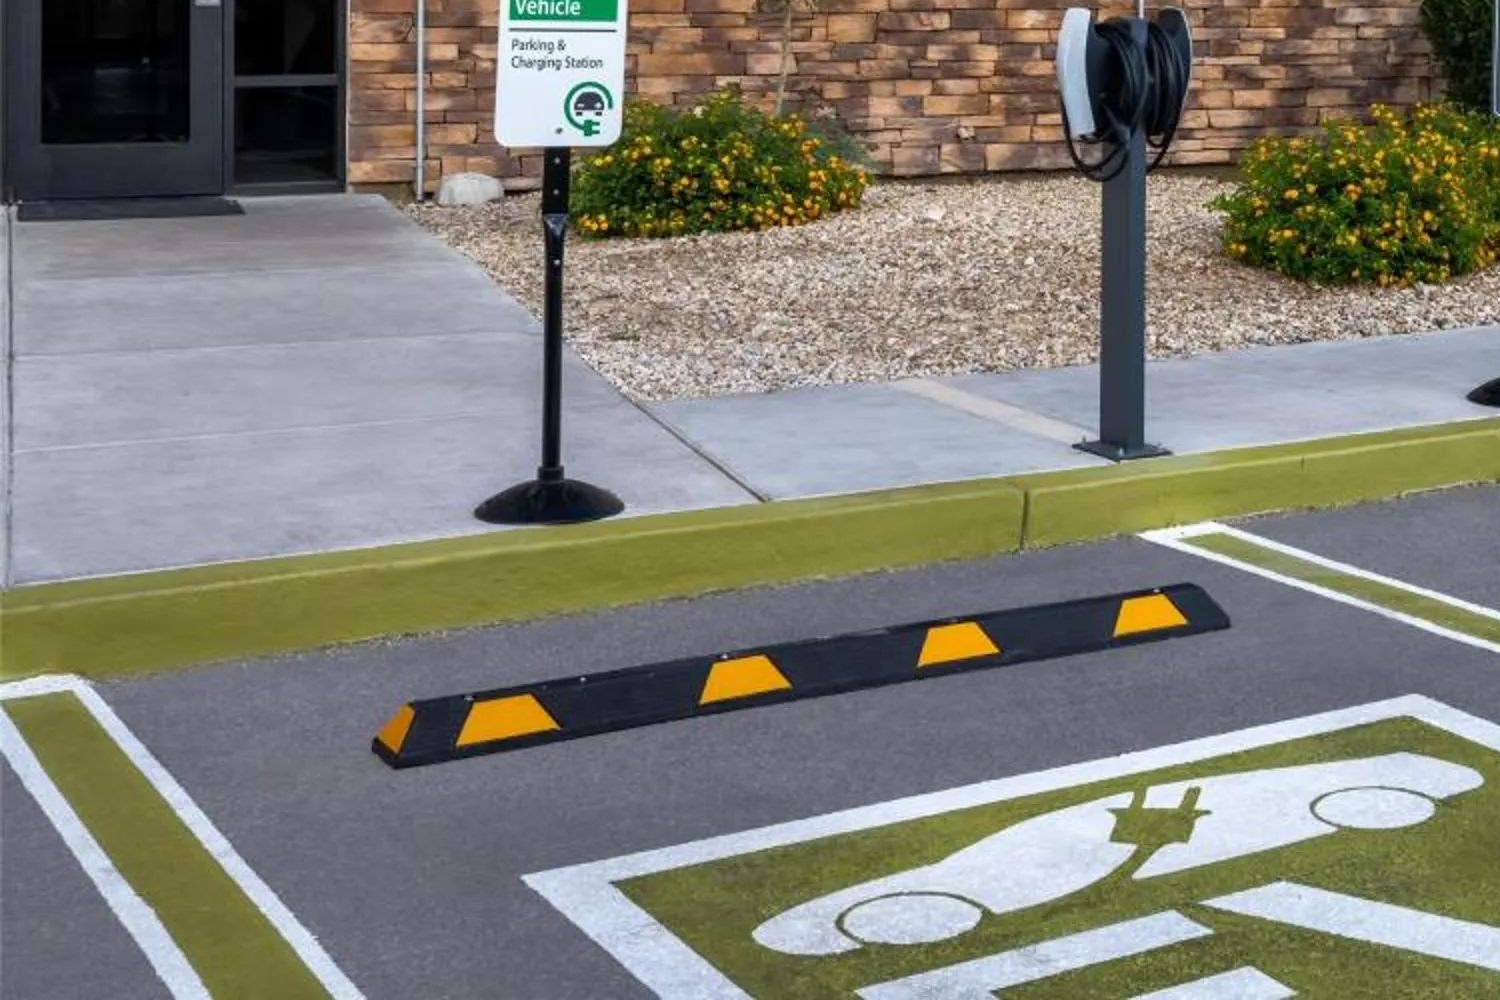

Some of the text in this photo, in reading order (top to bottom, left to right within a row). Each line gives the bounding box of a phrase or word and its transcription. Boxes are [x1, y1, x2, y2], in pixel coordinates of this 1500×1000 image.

[511, 38, 566, 54] Parking &
[511, 55, 604, 71] Charging Station
